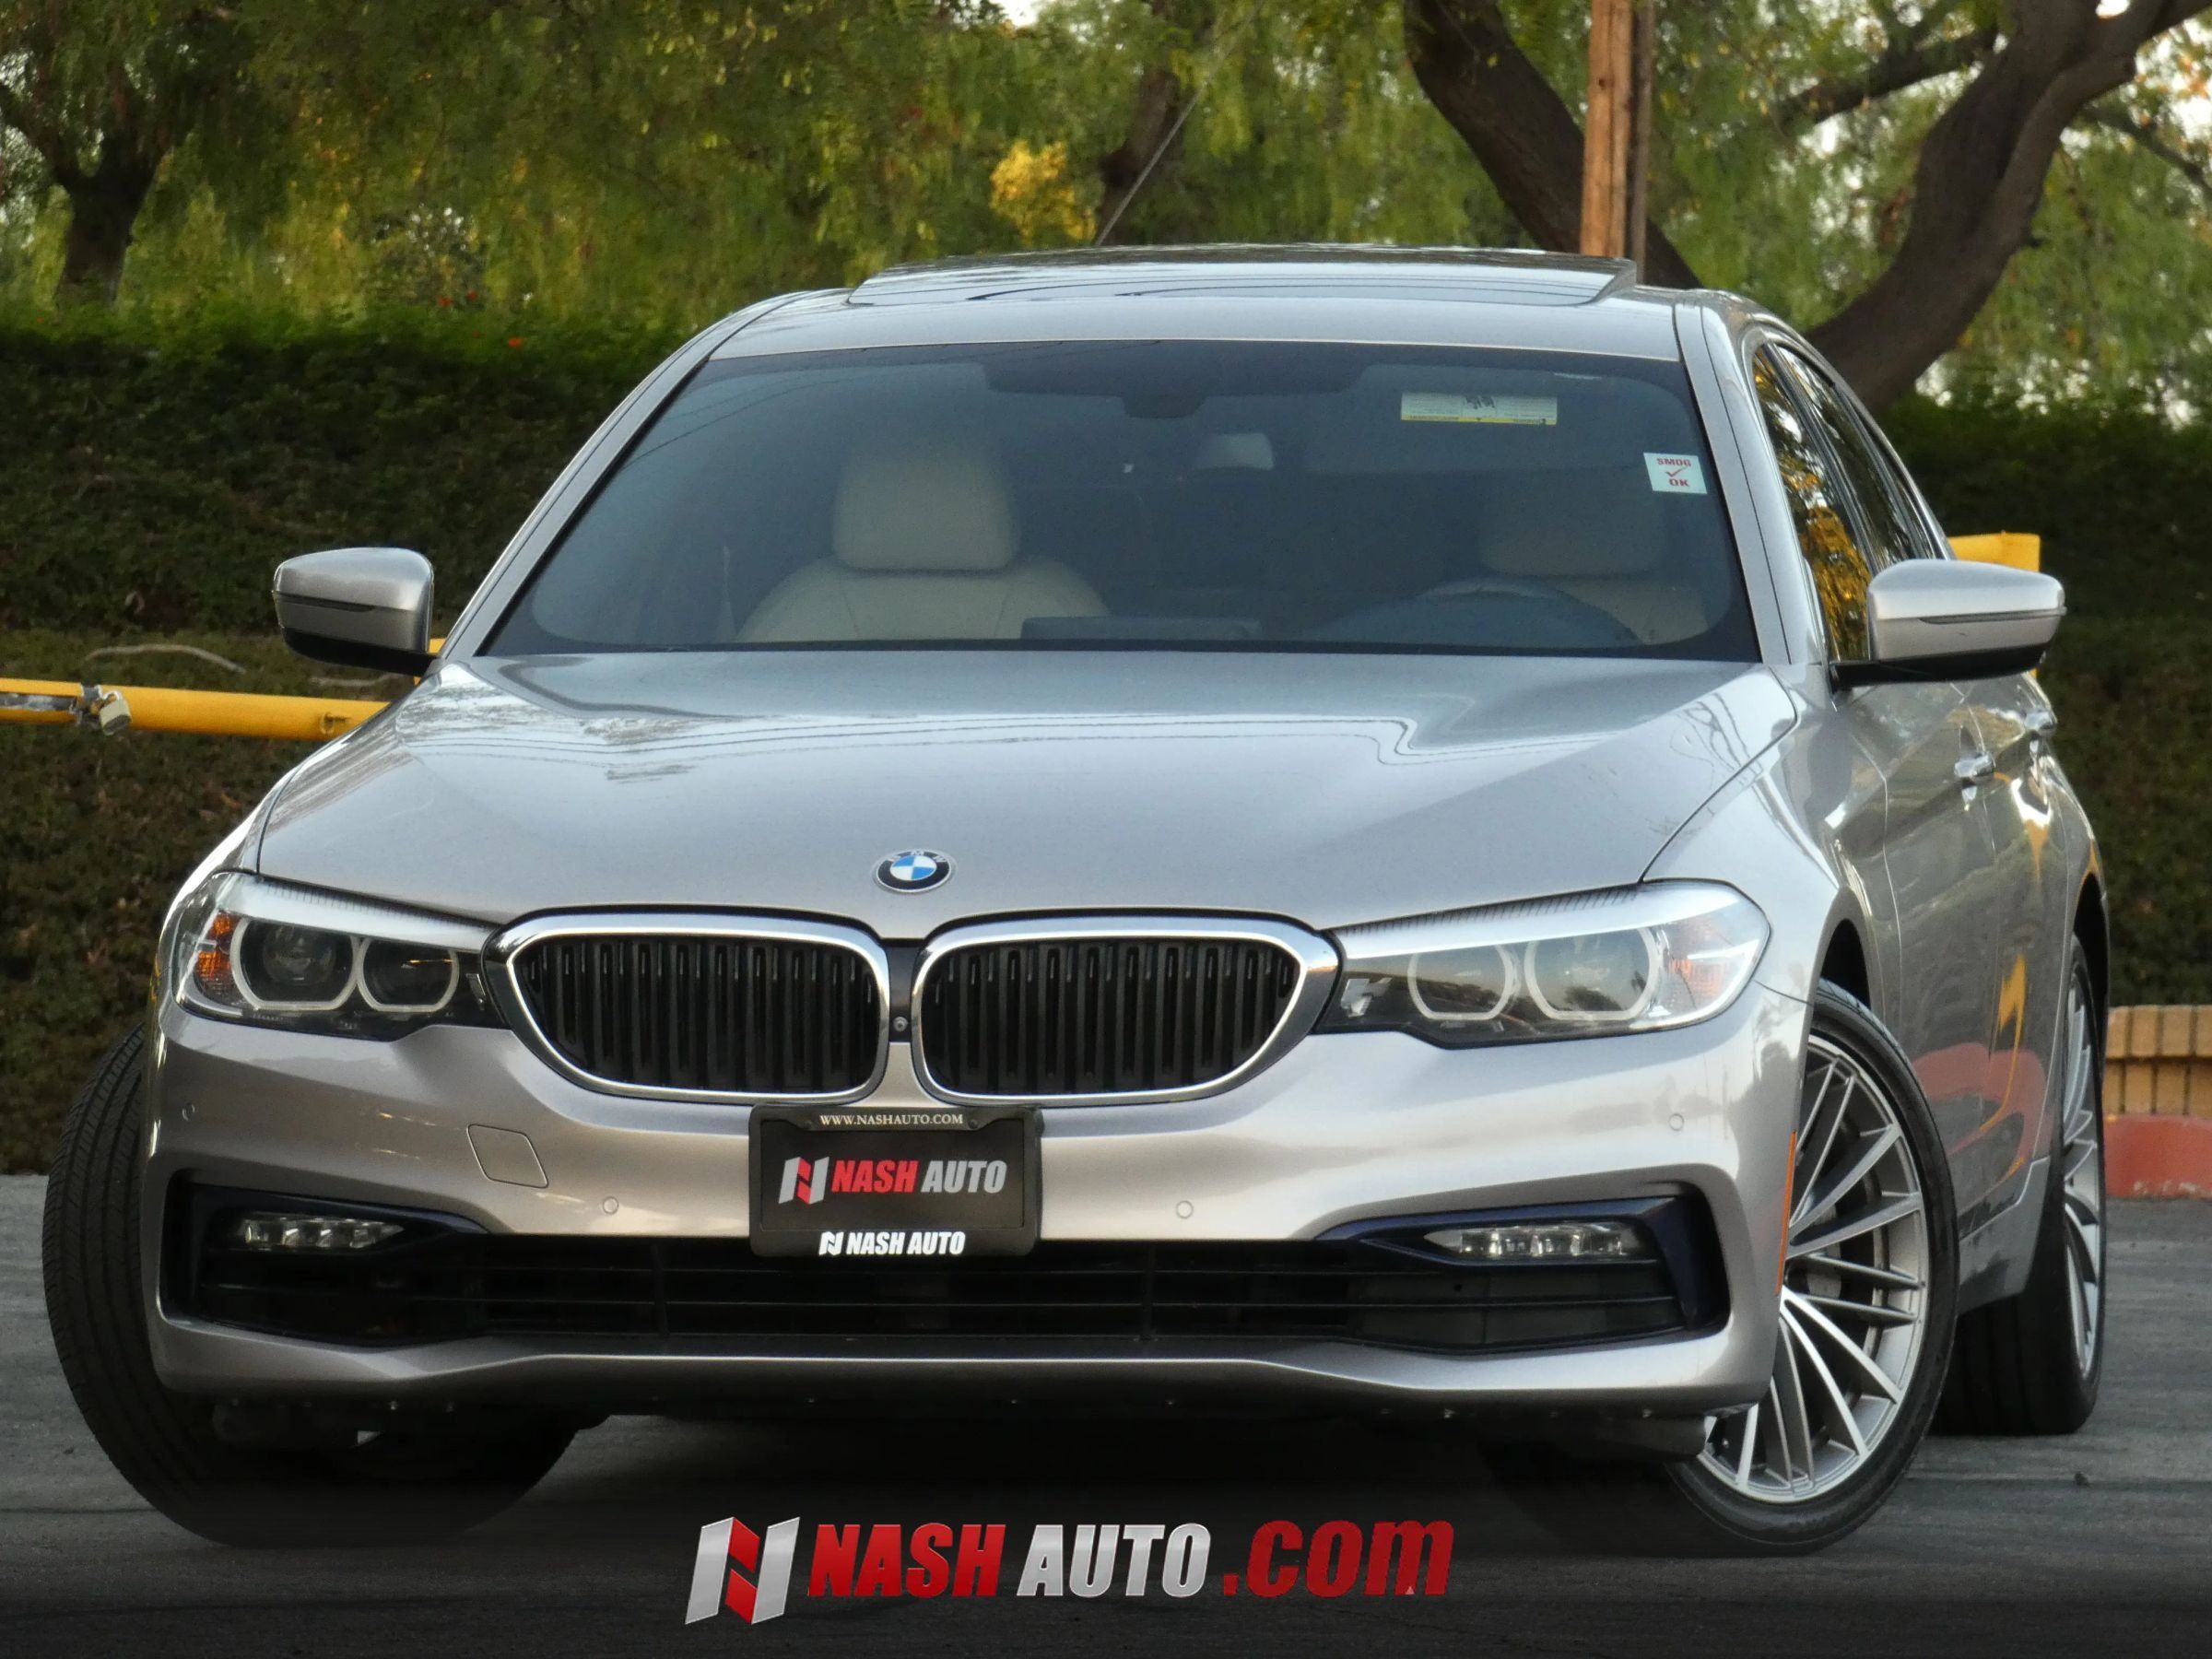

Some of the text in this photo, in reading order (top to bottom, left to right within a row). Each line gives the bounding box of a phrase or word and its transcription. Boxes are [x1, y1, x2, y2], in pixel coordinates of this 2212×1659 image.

[1657, 457, 1691, 467] SMOG
[1669, 478, 1689, 487] OK
[819, 1114, 963, 1126] WWW.NASHAUTO.COM
[831, 1159, 920, 1194] NASH
[920, 1159, 1007, 1194] AUTO
[846, 1230, 905, 1255] NASH
[906, 1230, 966, 1255] AUTO
